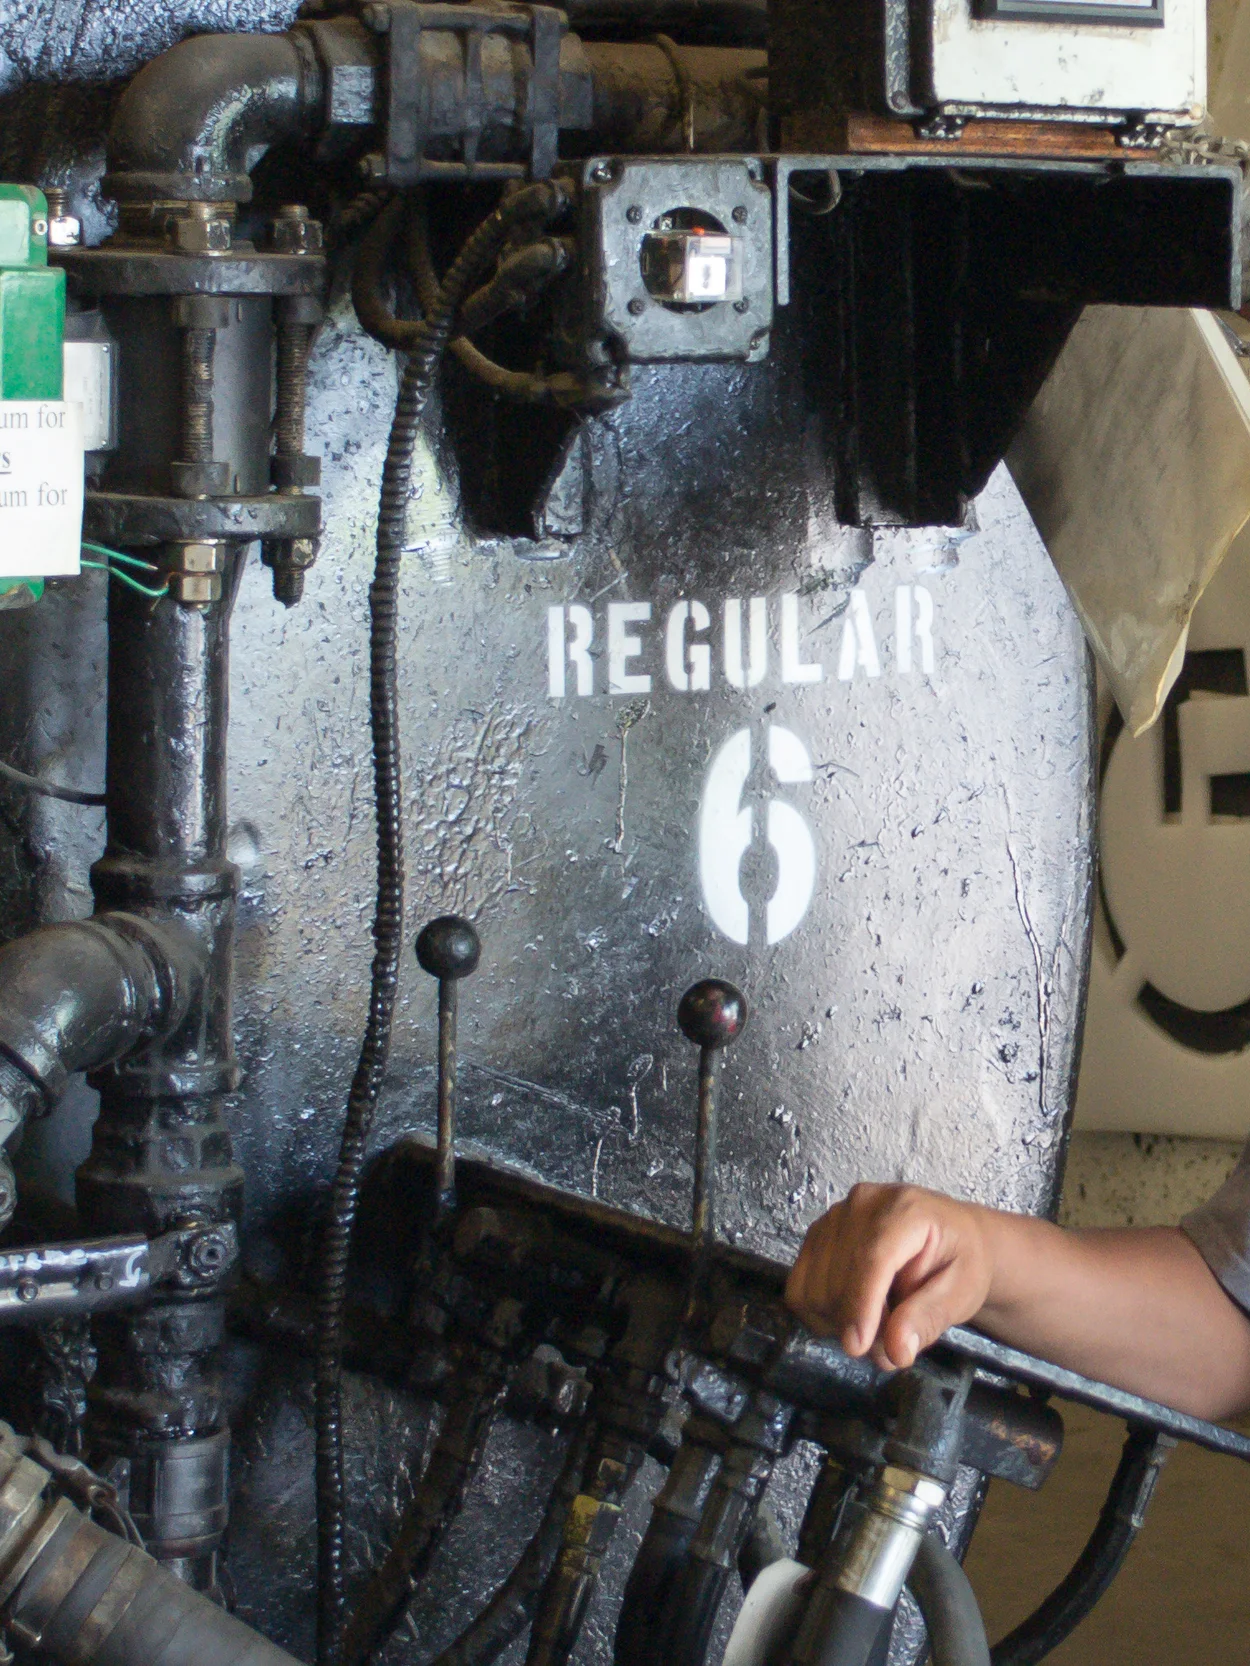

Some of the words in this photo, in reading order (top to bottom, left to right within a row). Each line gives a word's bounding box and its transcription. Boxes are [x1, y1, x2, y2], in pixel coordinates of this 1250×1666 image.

[38, 403, 66, 429] for
[38, 481, 68, 506] for
[547, 585, 935, 698] REGULAR
[700, 724, 816, 946] 6
